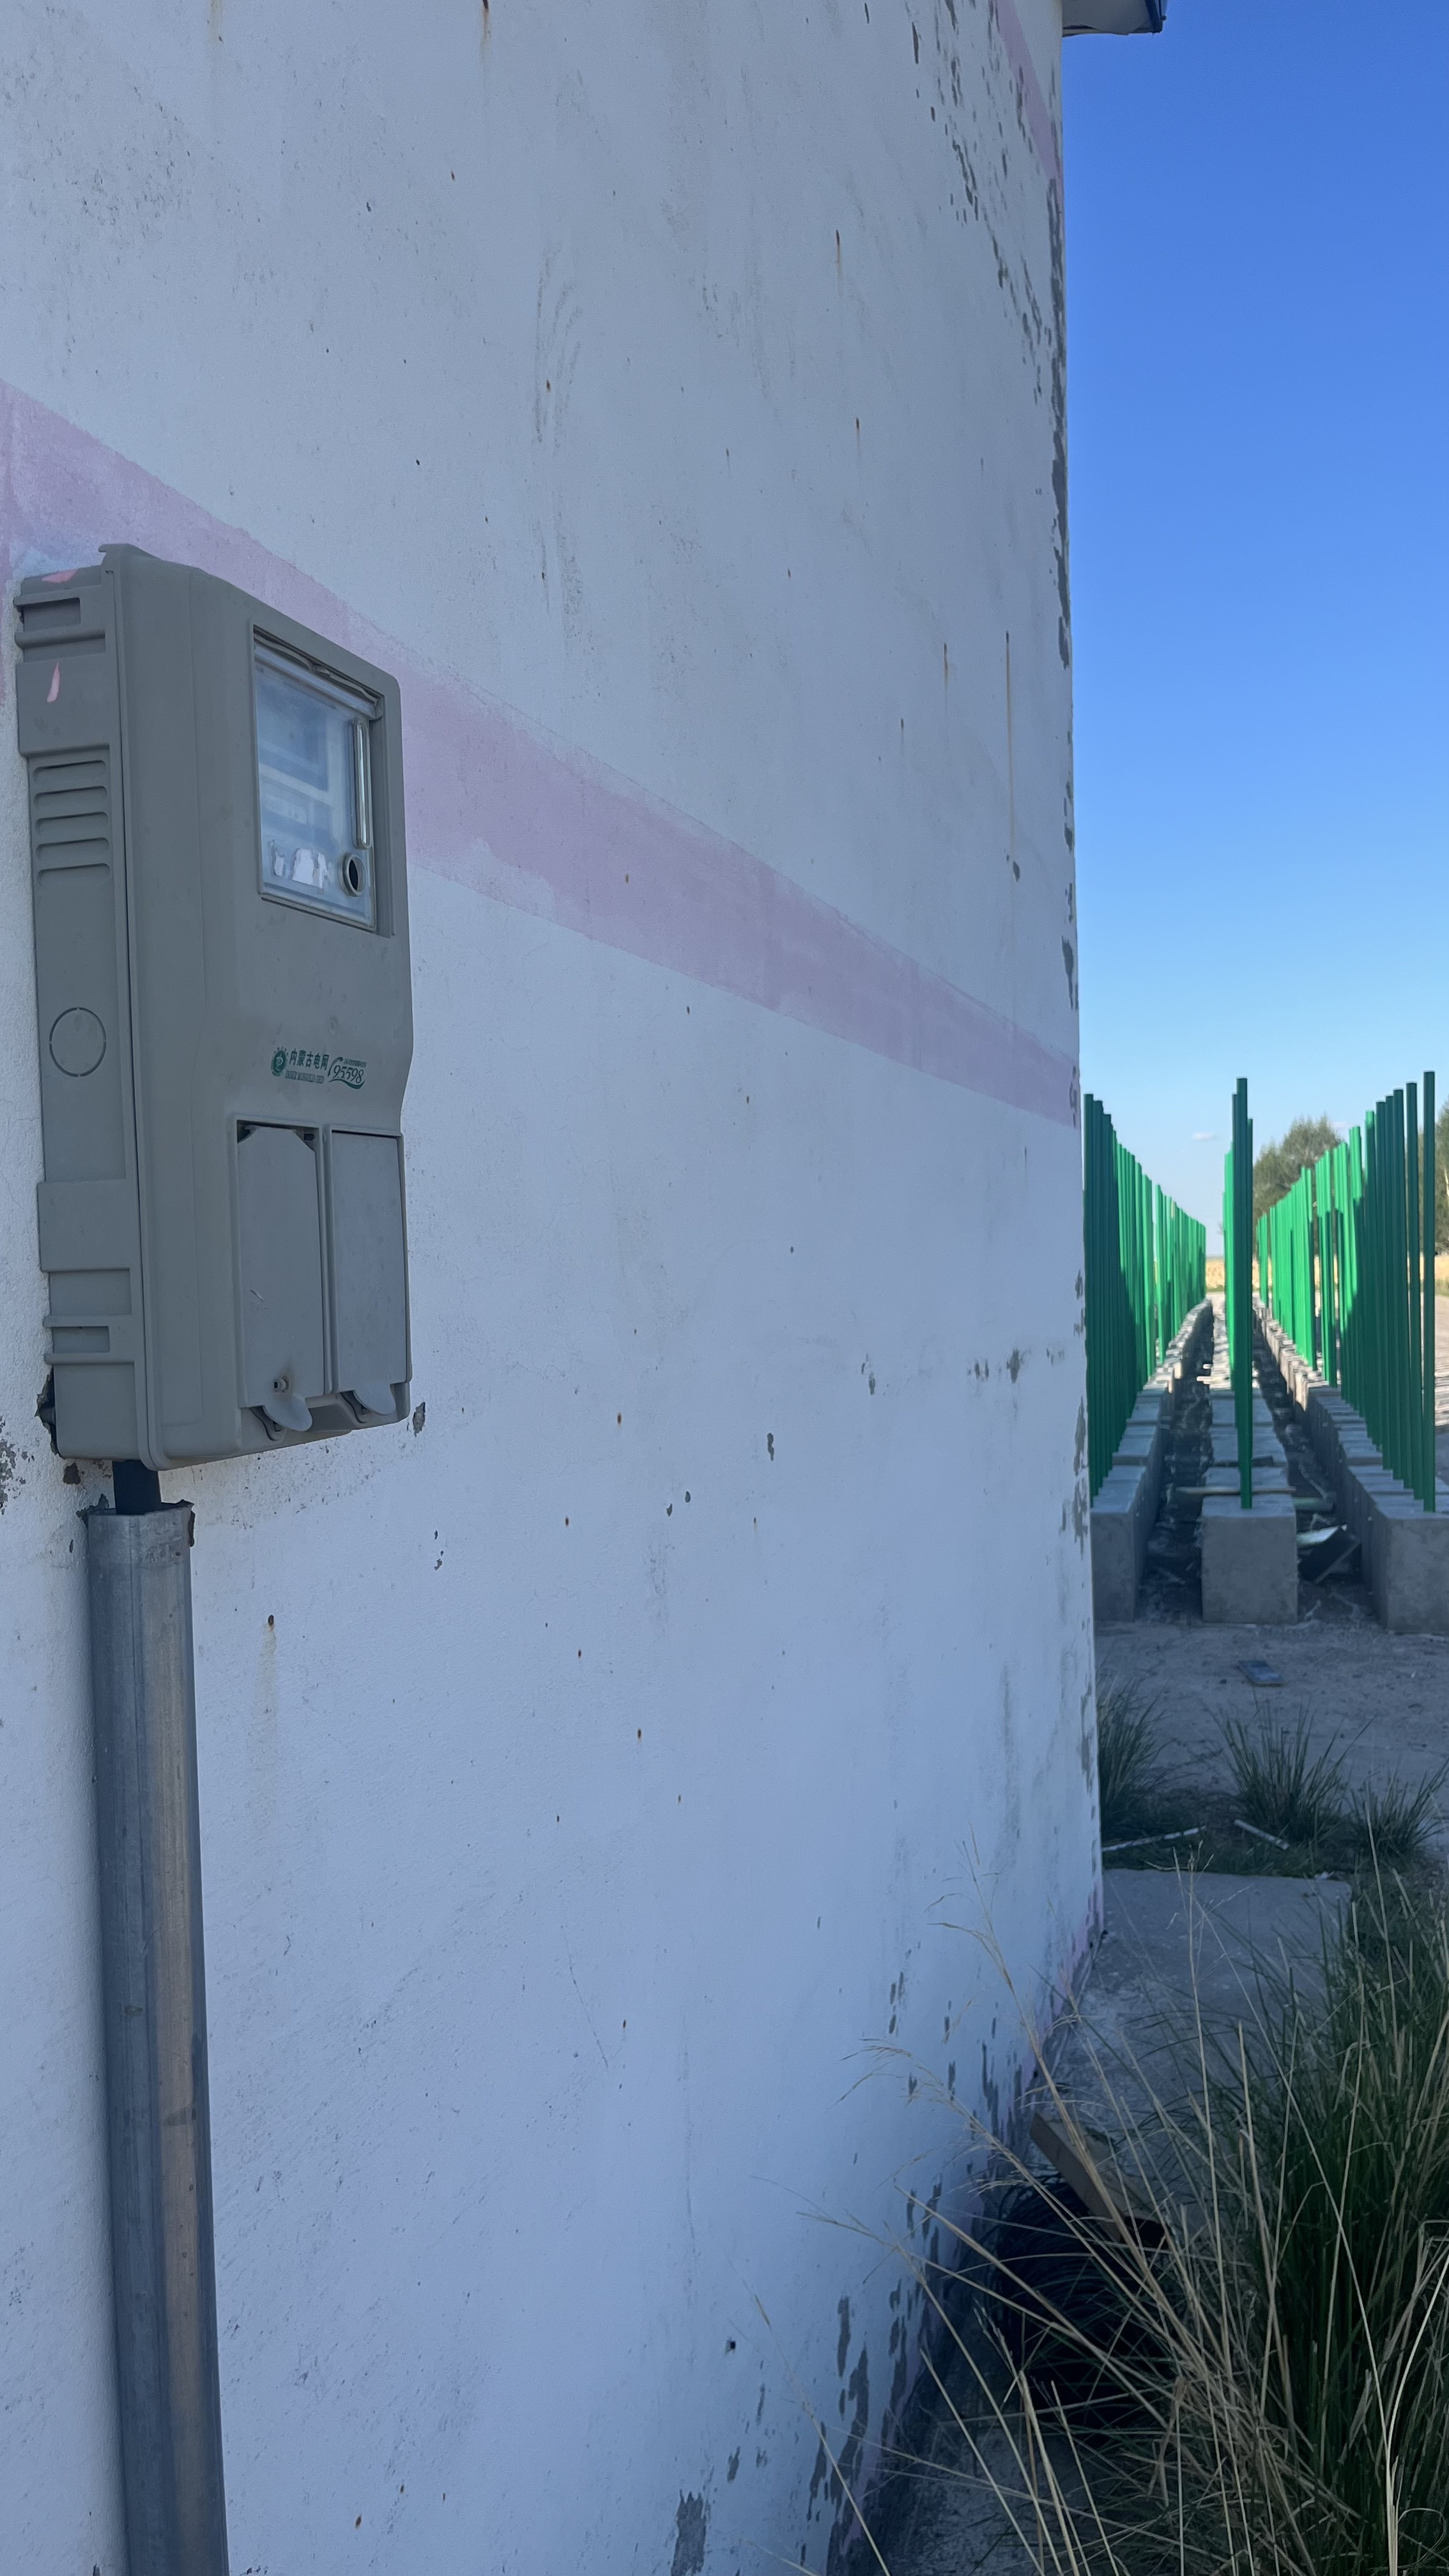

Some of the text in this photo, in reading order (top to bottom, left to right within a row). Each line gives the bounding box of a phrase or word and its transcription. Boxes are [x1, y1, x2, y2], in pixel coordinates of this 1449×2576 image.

[289, 1048, 329, 1070] 内蒙古电网
[333, 1065, 364, 1084] 95598
